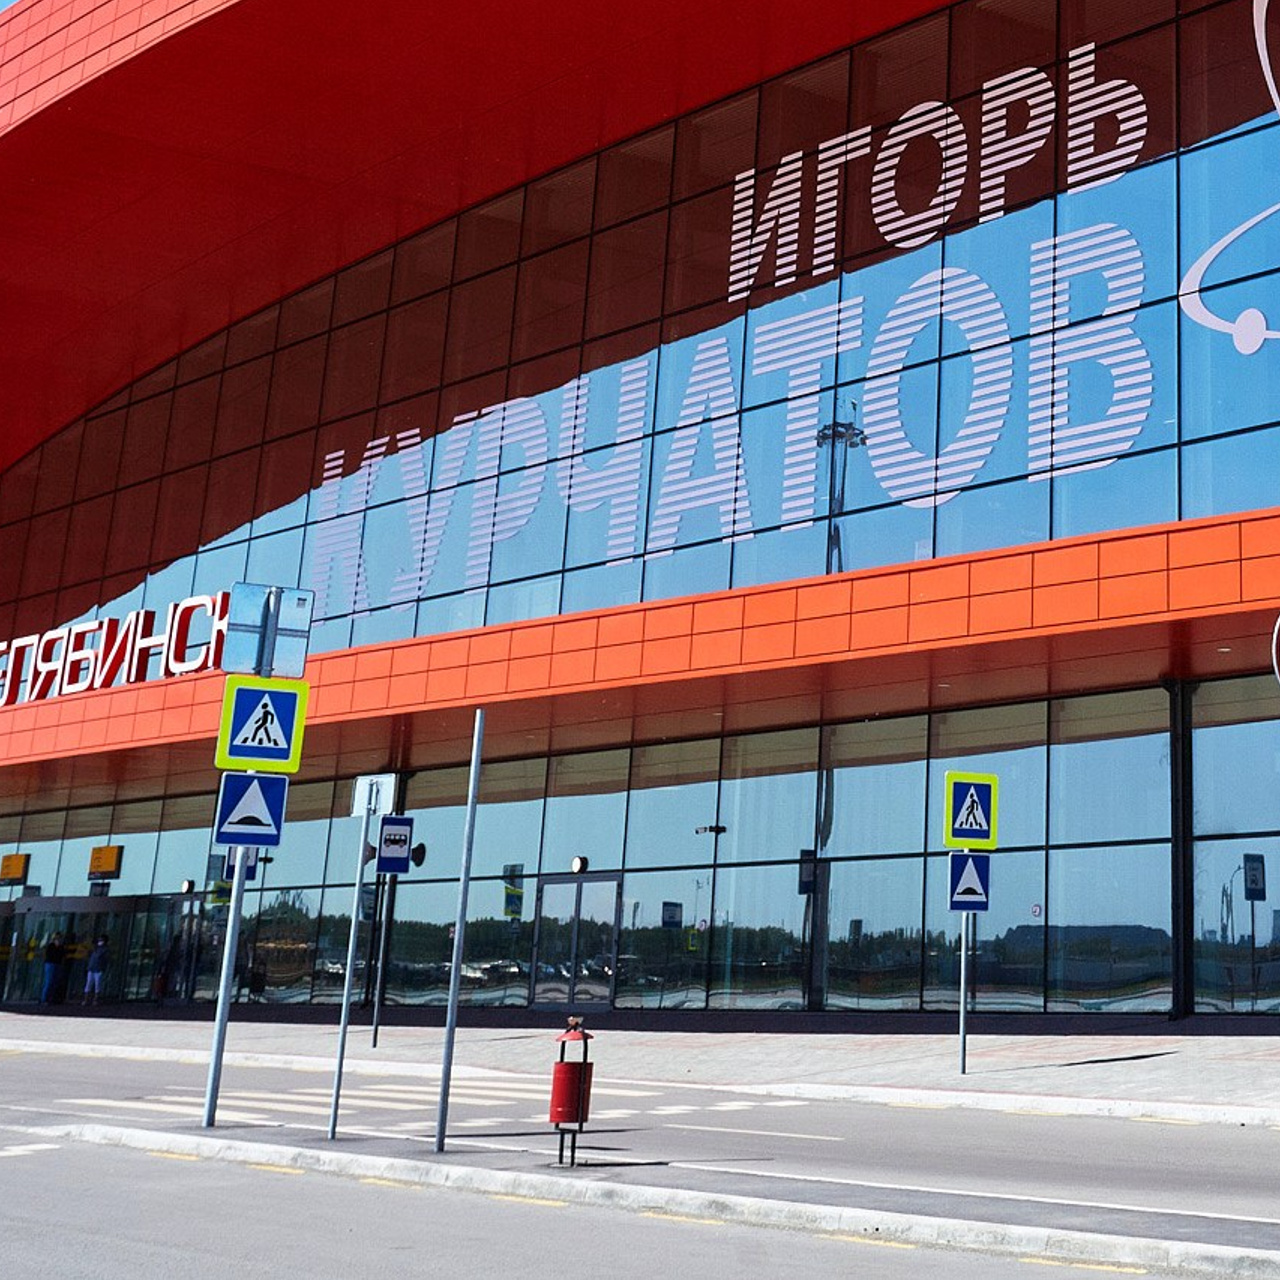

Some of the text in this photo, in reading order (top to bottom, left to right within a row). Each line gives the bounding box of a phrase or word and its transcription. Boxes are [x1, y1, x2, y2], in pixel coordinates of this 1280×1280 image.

[728, 41, 1148, 302] ИГОРЬ
[311, 222, 1152, 627] КУРЧАТОВ
[0, 591, 229, 707] ЛЯБИНСК
